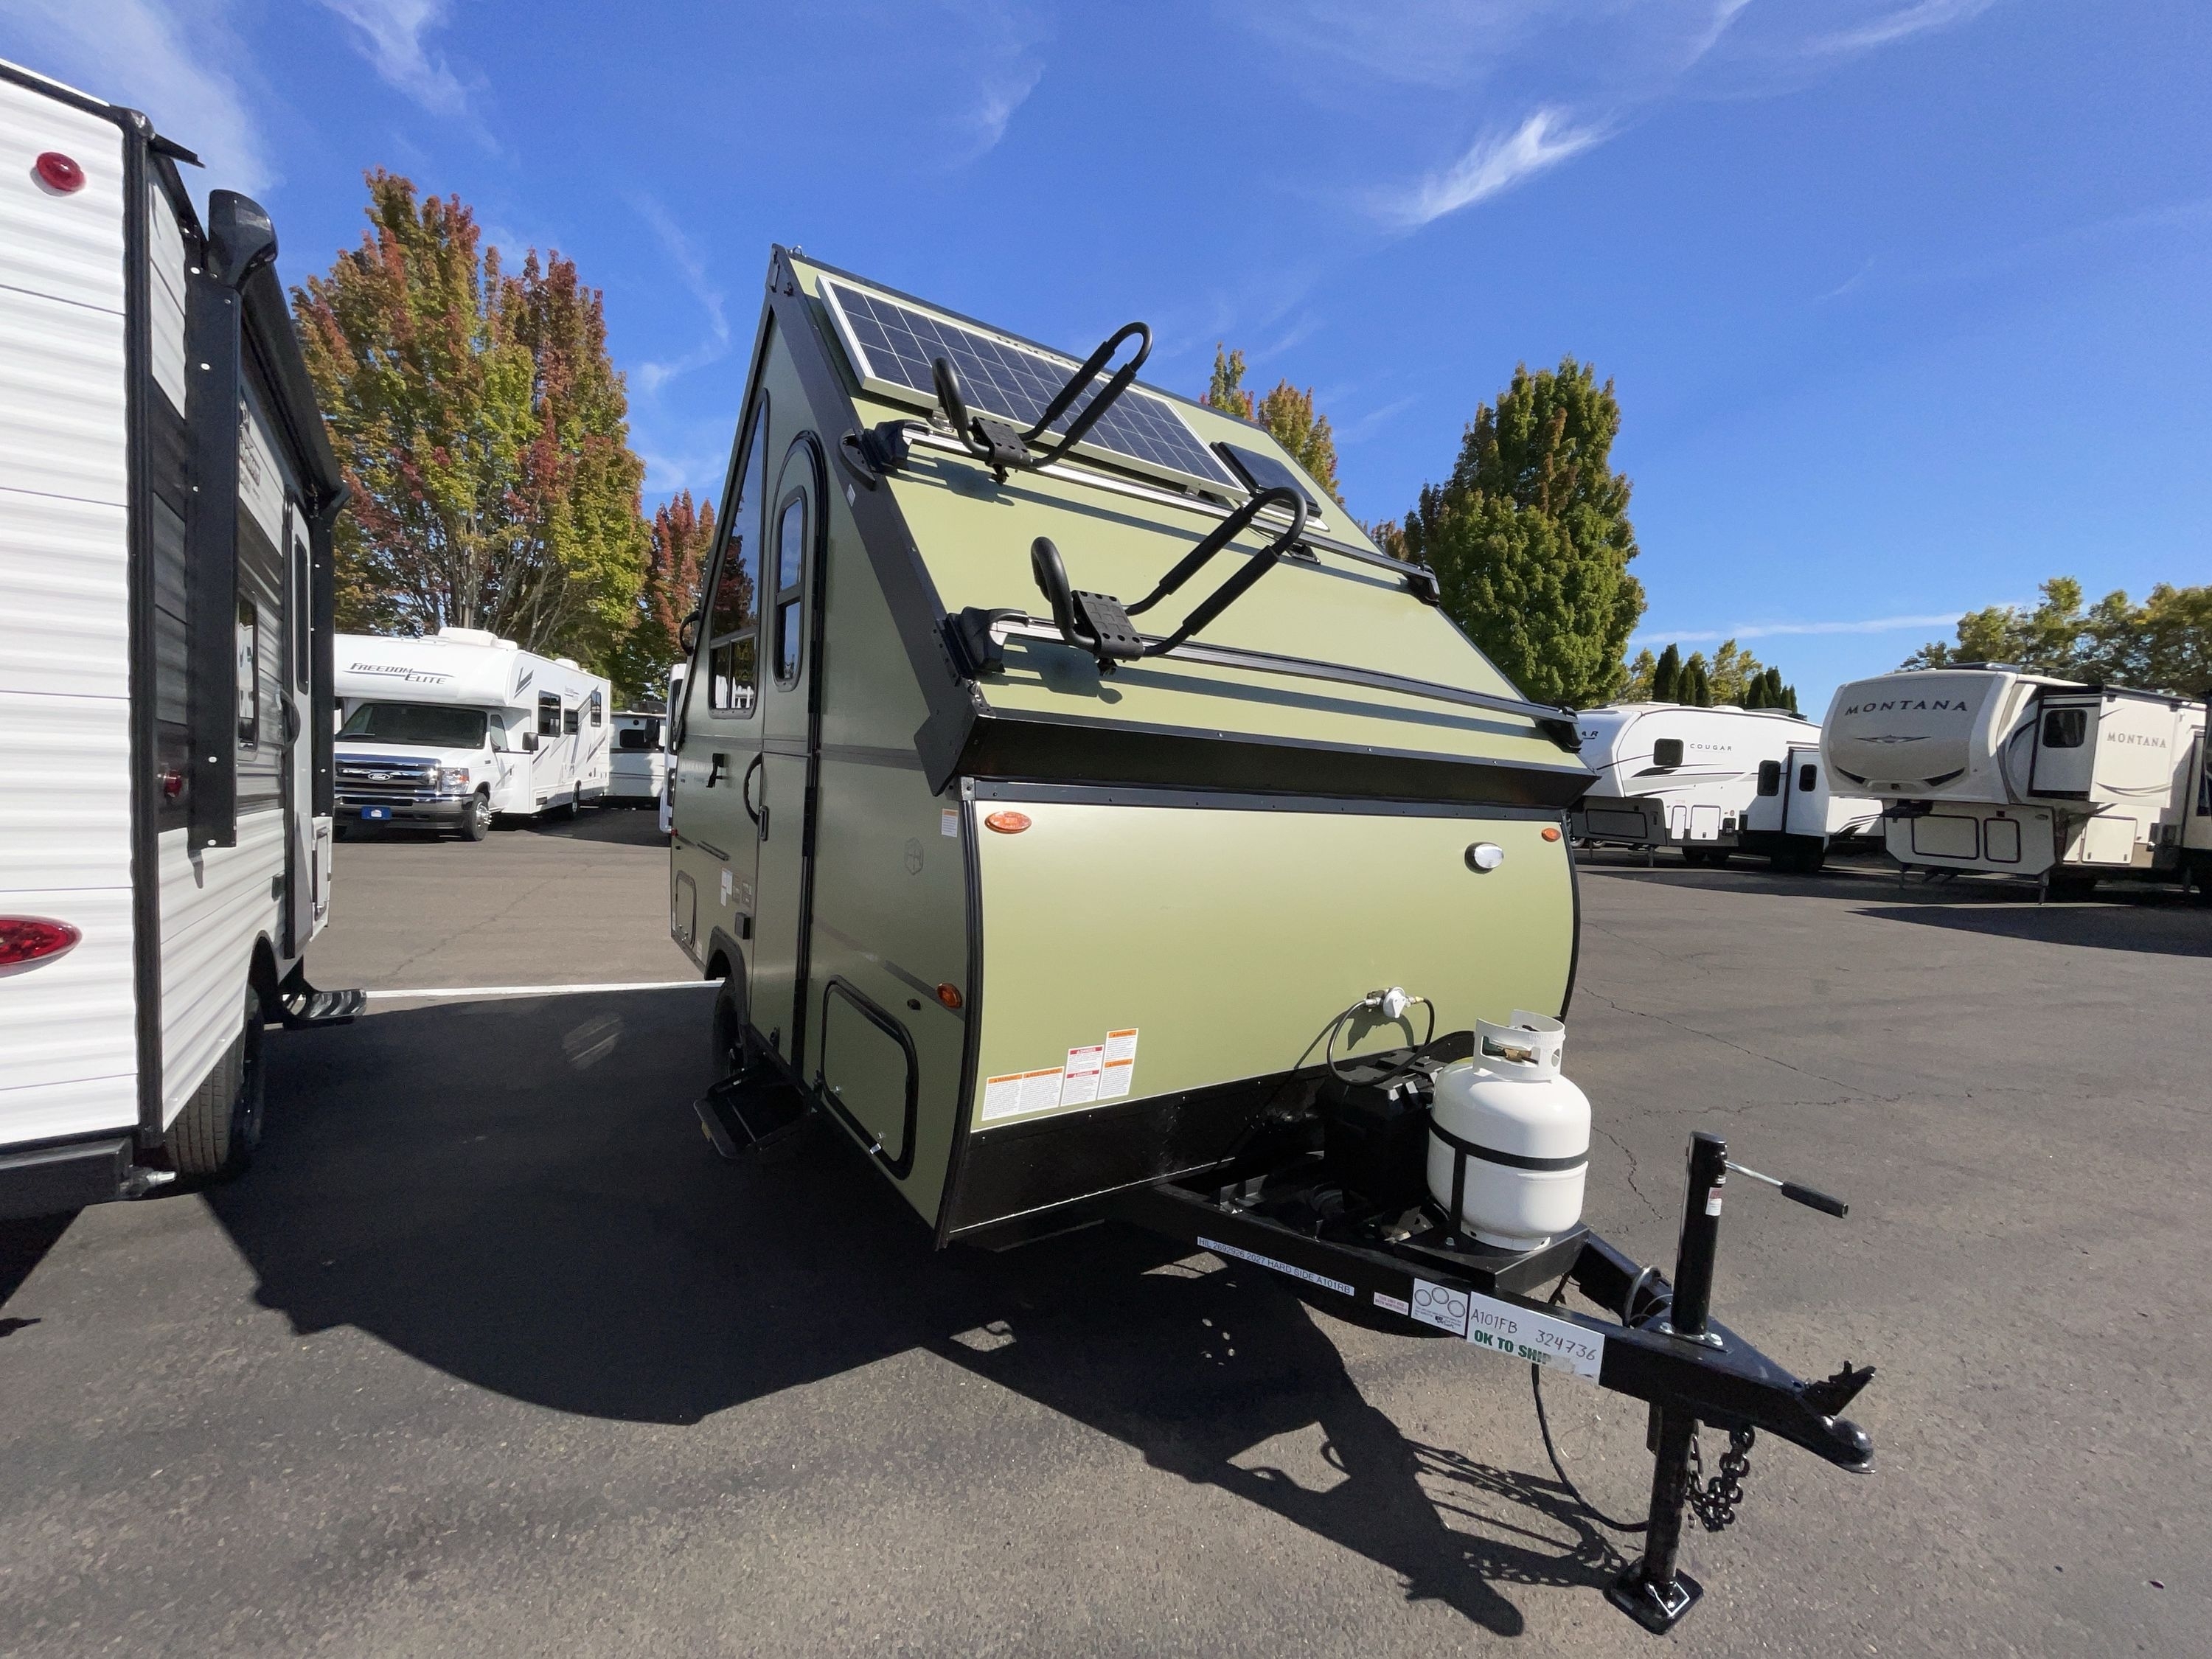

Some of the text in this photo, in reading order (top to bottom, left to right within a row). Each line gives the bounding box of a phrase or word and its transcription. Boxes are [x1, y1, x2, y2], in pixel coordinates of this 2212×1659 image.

[350, 663, 413, 674] FREEDOM
[405, 674, 446, 684] ELITE
[1845, 700, 1967, 716] MONTANA
[1689, 743, 1732, 751] COUGAR
[2107, 731, 2166, 748] MONTANA
[1199, 1239, 1211, 1248] HIL
[1267, 1259, 1290, 1273] HARD
[1294, 1268, 1314, 1281] SIDE
[1316, 1277, 1351, 1293] A101RB
[1471, 1309, 1517, 1334] A101FB
[1535, 1329, 1597, 1360] 324736
[1474, 1329, 1552, 1365] OK TO SHIP
